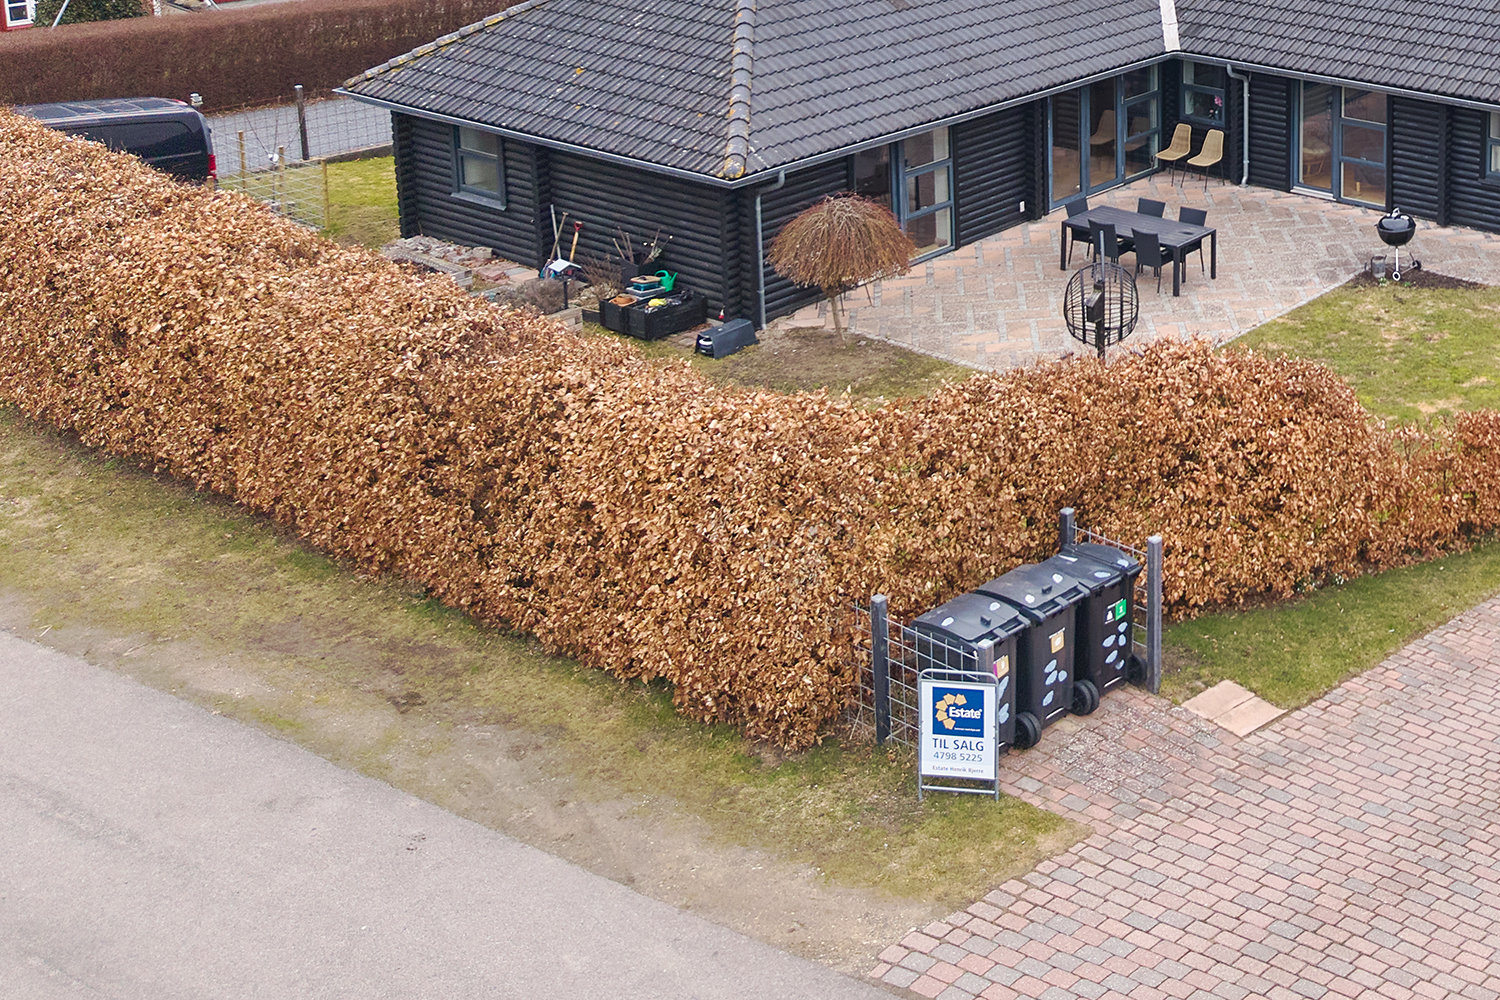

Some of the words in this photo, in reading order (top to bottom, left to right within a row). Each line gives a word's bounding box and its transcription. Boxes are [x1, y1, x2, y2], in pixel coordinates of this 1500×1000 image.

[949, 706, 981, 719] Estate
[932, 738, 949, 749] TIL
[953, 739, 984, 751] SALG
[933, 751, 957, 760] 4798
[959, 753, 983, 762] 5225
